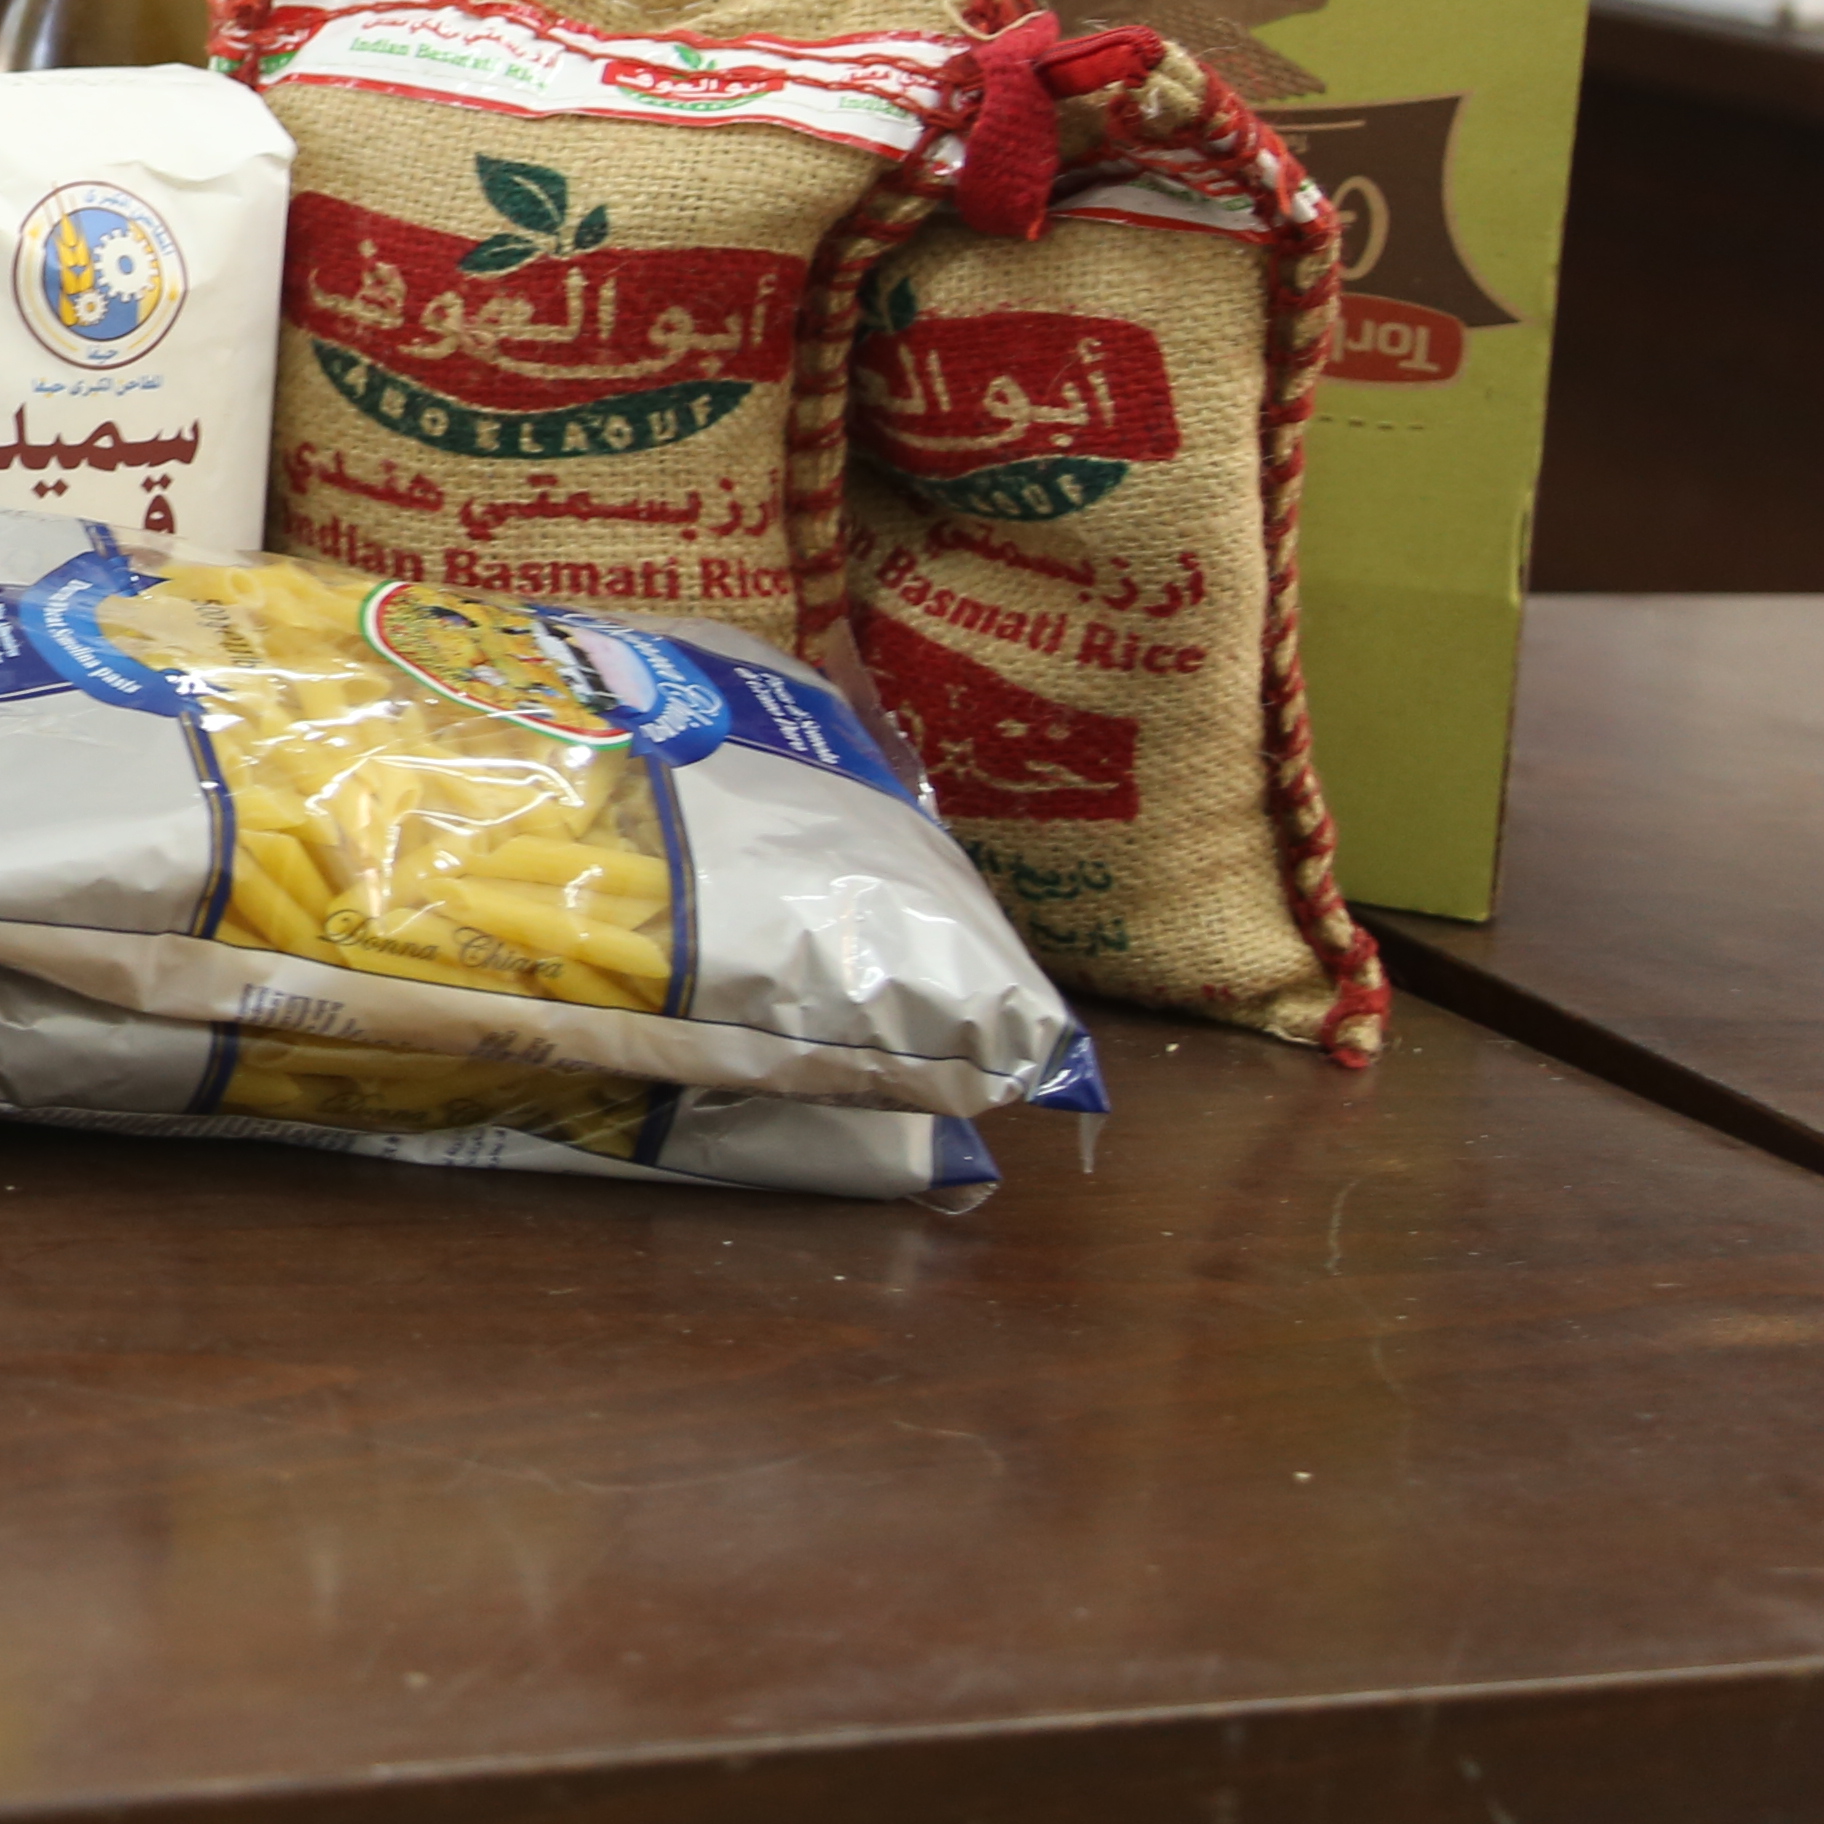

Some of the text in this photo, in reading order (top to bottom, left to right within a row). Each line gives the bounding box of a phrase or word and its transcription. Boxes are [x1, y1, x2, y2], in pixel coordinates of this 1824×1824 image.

[444, 545, 679, 601] Basmati
[875, 546, 1207, 676] Basmati Rice
[86, 667, 142, 695] pasta
[452, 926, 564, 981] Chiara
